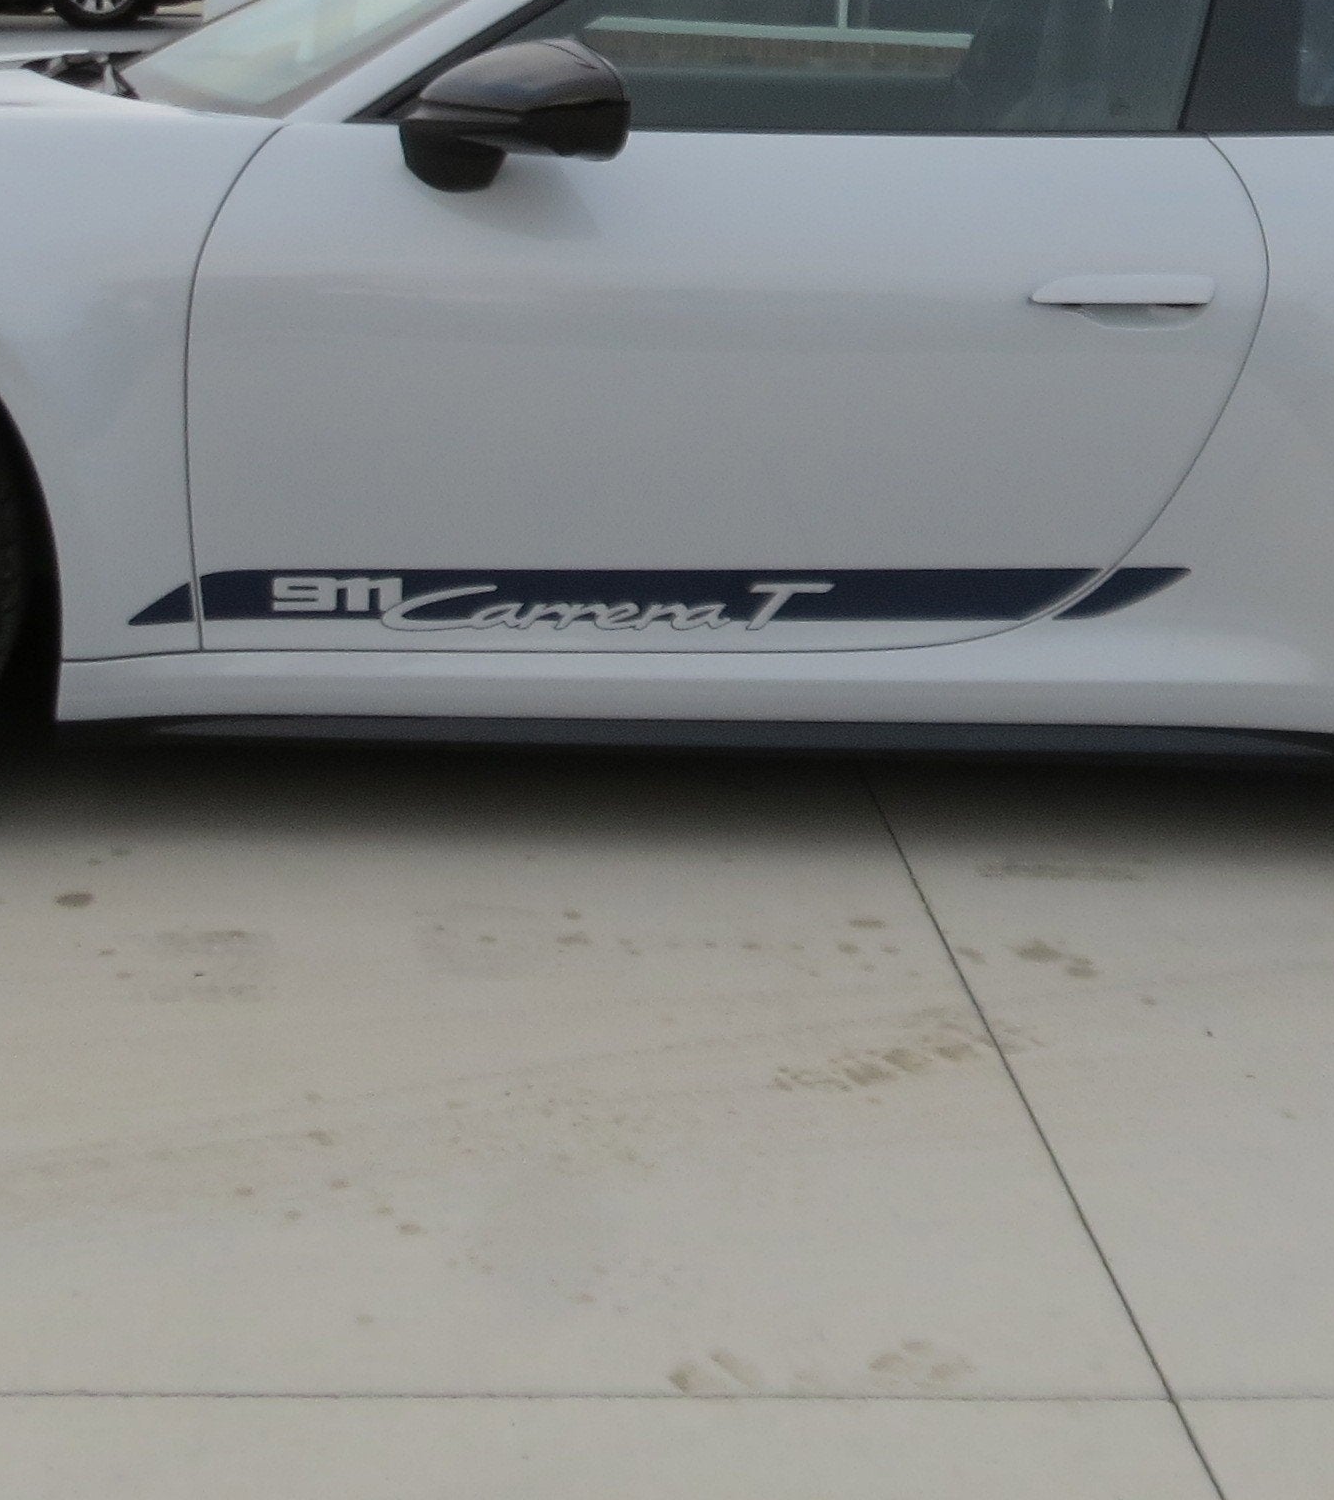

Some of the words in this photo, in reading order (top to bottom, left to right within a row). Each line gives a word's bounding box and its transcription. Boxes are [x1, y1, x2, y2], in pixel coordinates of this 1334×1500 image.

[273, 577, 403, 612] 911
[381, 584, 731, 632] Carrera
[745, 583, 836, 631] T
